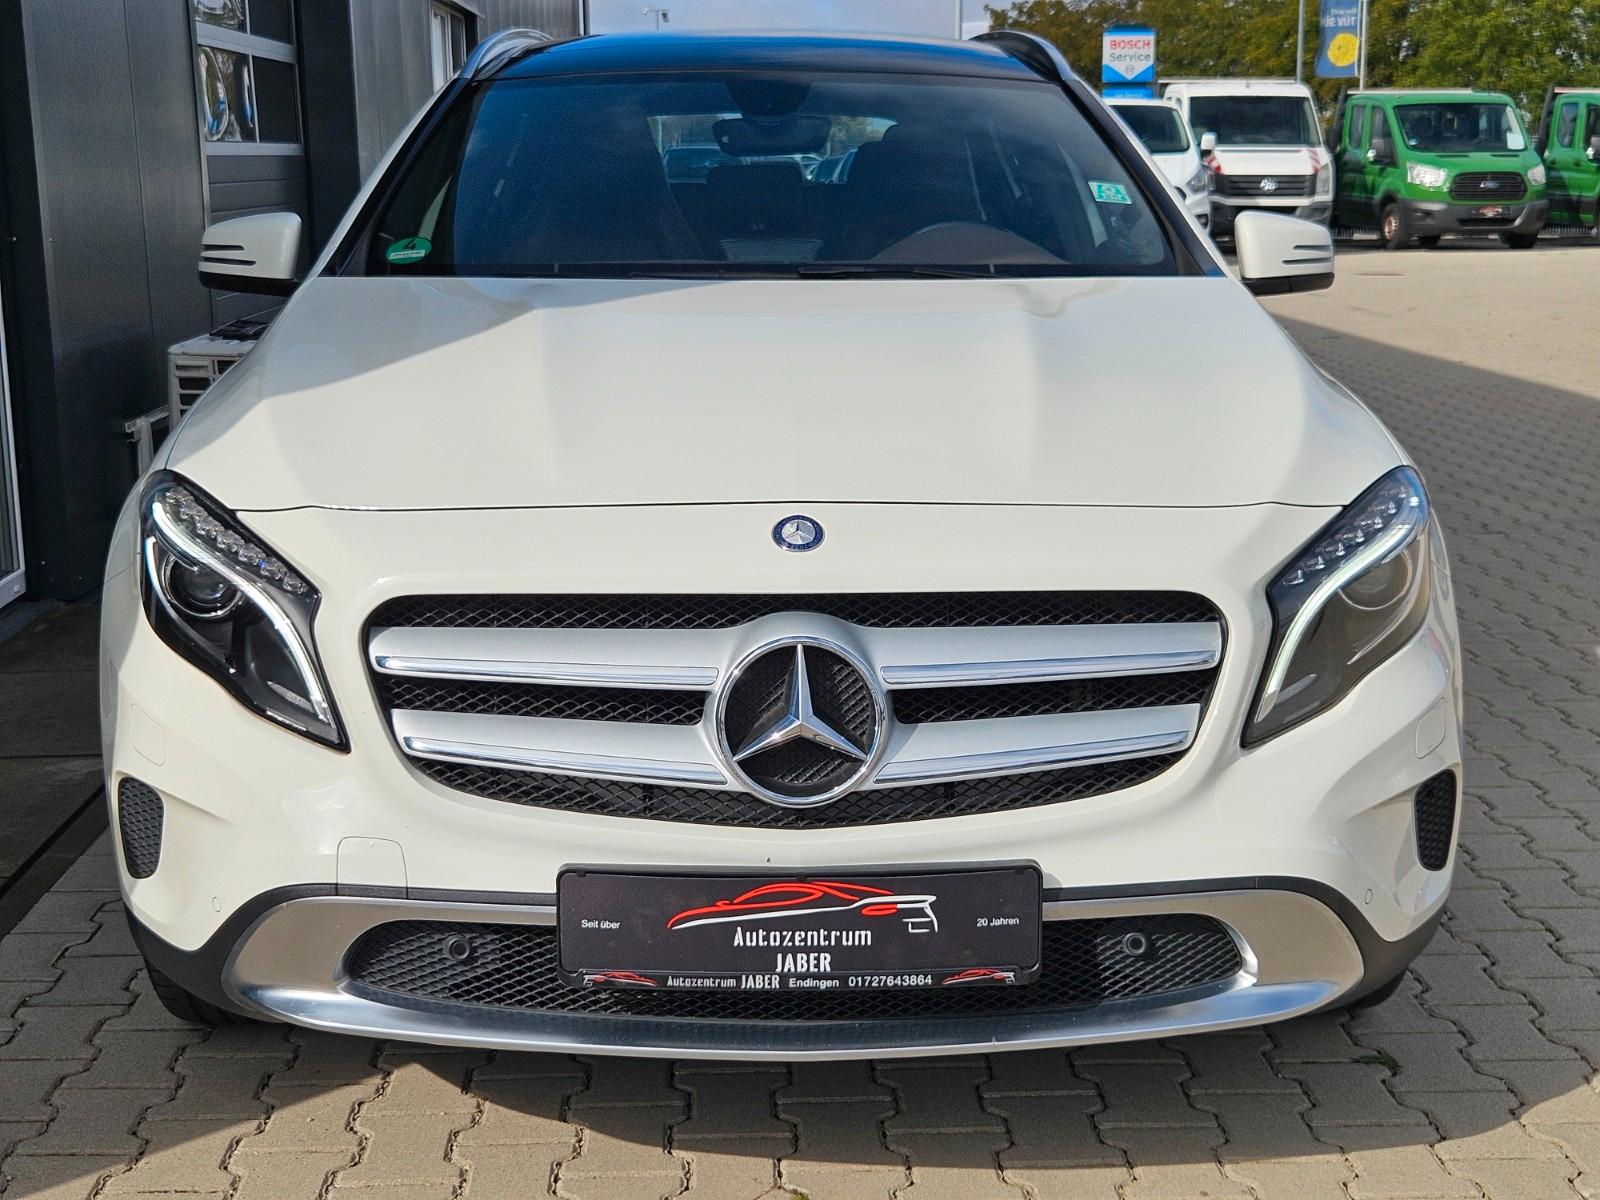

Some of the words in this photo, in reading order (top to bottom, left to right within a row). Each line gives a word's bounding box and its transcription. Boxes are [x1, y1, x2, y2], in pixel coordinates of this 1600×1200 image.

[1110, 39, 1151, 49] BOSCH
[1110, 51, 1151, 62] Service
[402, 238, 417, 250] 4
[581, 919, 599, 929] Seit
[600, 919, 621, 929] über
[976, 918, 988, 927] 20
[990, 917, 1020, 926] Jahren
[733, 926, 872, 947] Autozentrum
[775, 952, 832, 972] JABER
[666, 975, 737, 988] Autozentrum
[741, 974, 780, 989] JABER
[788, 977, 840, 989] Endingen
[848, 974, 933, 988] 01727643864
